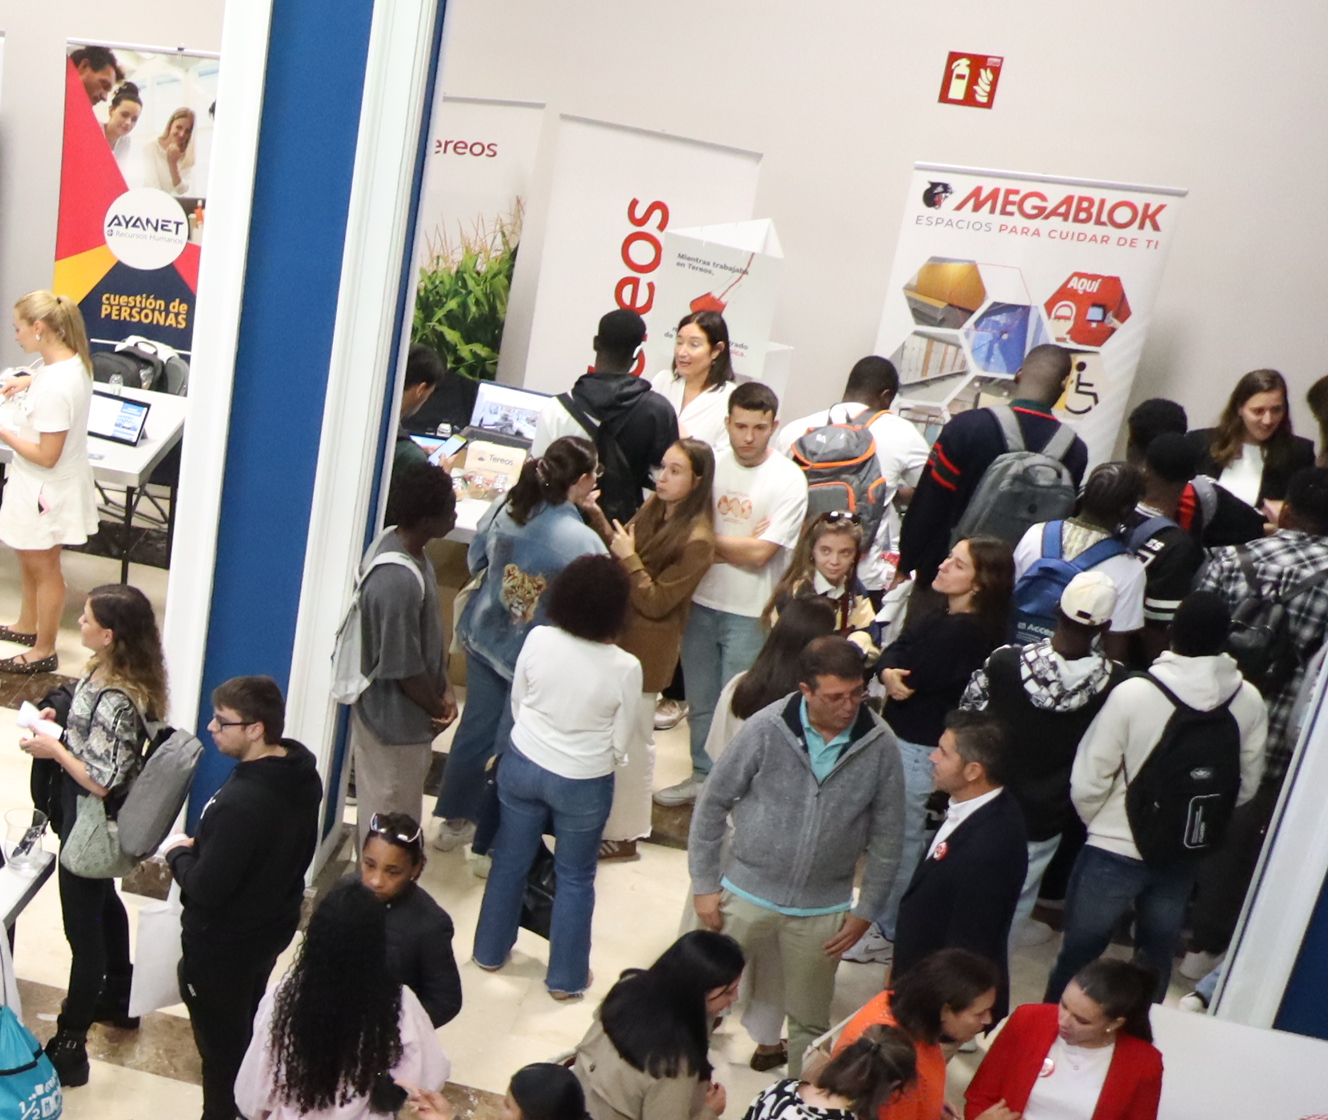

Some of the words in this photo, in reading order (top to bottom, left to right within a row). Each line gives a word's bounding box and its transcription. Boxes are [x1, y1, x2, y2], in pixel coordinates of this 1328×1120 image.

[953, 185, 1168, 232] MEGABLOK
[107, 214, 185, 235] AYANET
[915, 215, 993, 233] ESPACIOS
[998, 223, 1041, 239] PARA
[1048, 229, 1111, 245] CUIDAR
[1116, 237, 1138, 248] DE
[1146, 240, 1160, 250] TI
[115, 230, 148, 240] Recursos
[149, 234, 184, 245] Humanos
[677, 253, 711, 266] Mientras
[101, 293, 165, 311] cuestión
[169, 298, 188, 314] de
[100, 304, 187, 329] PERSONAS
[489, 452, 514, 466] Tereos
